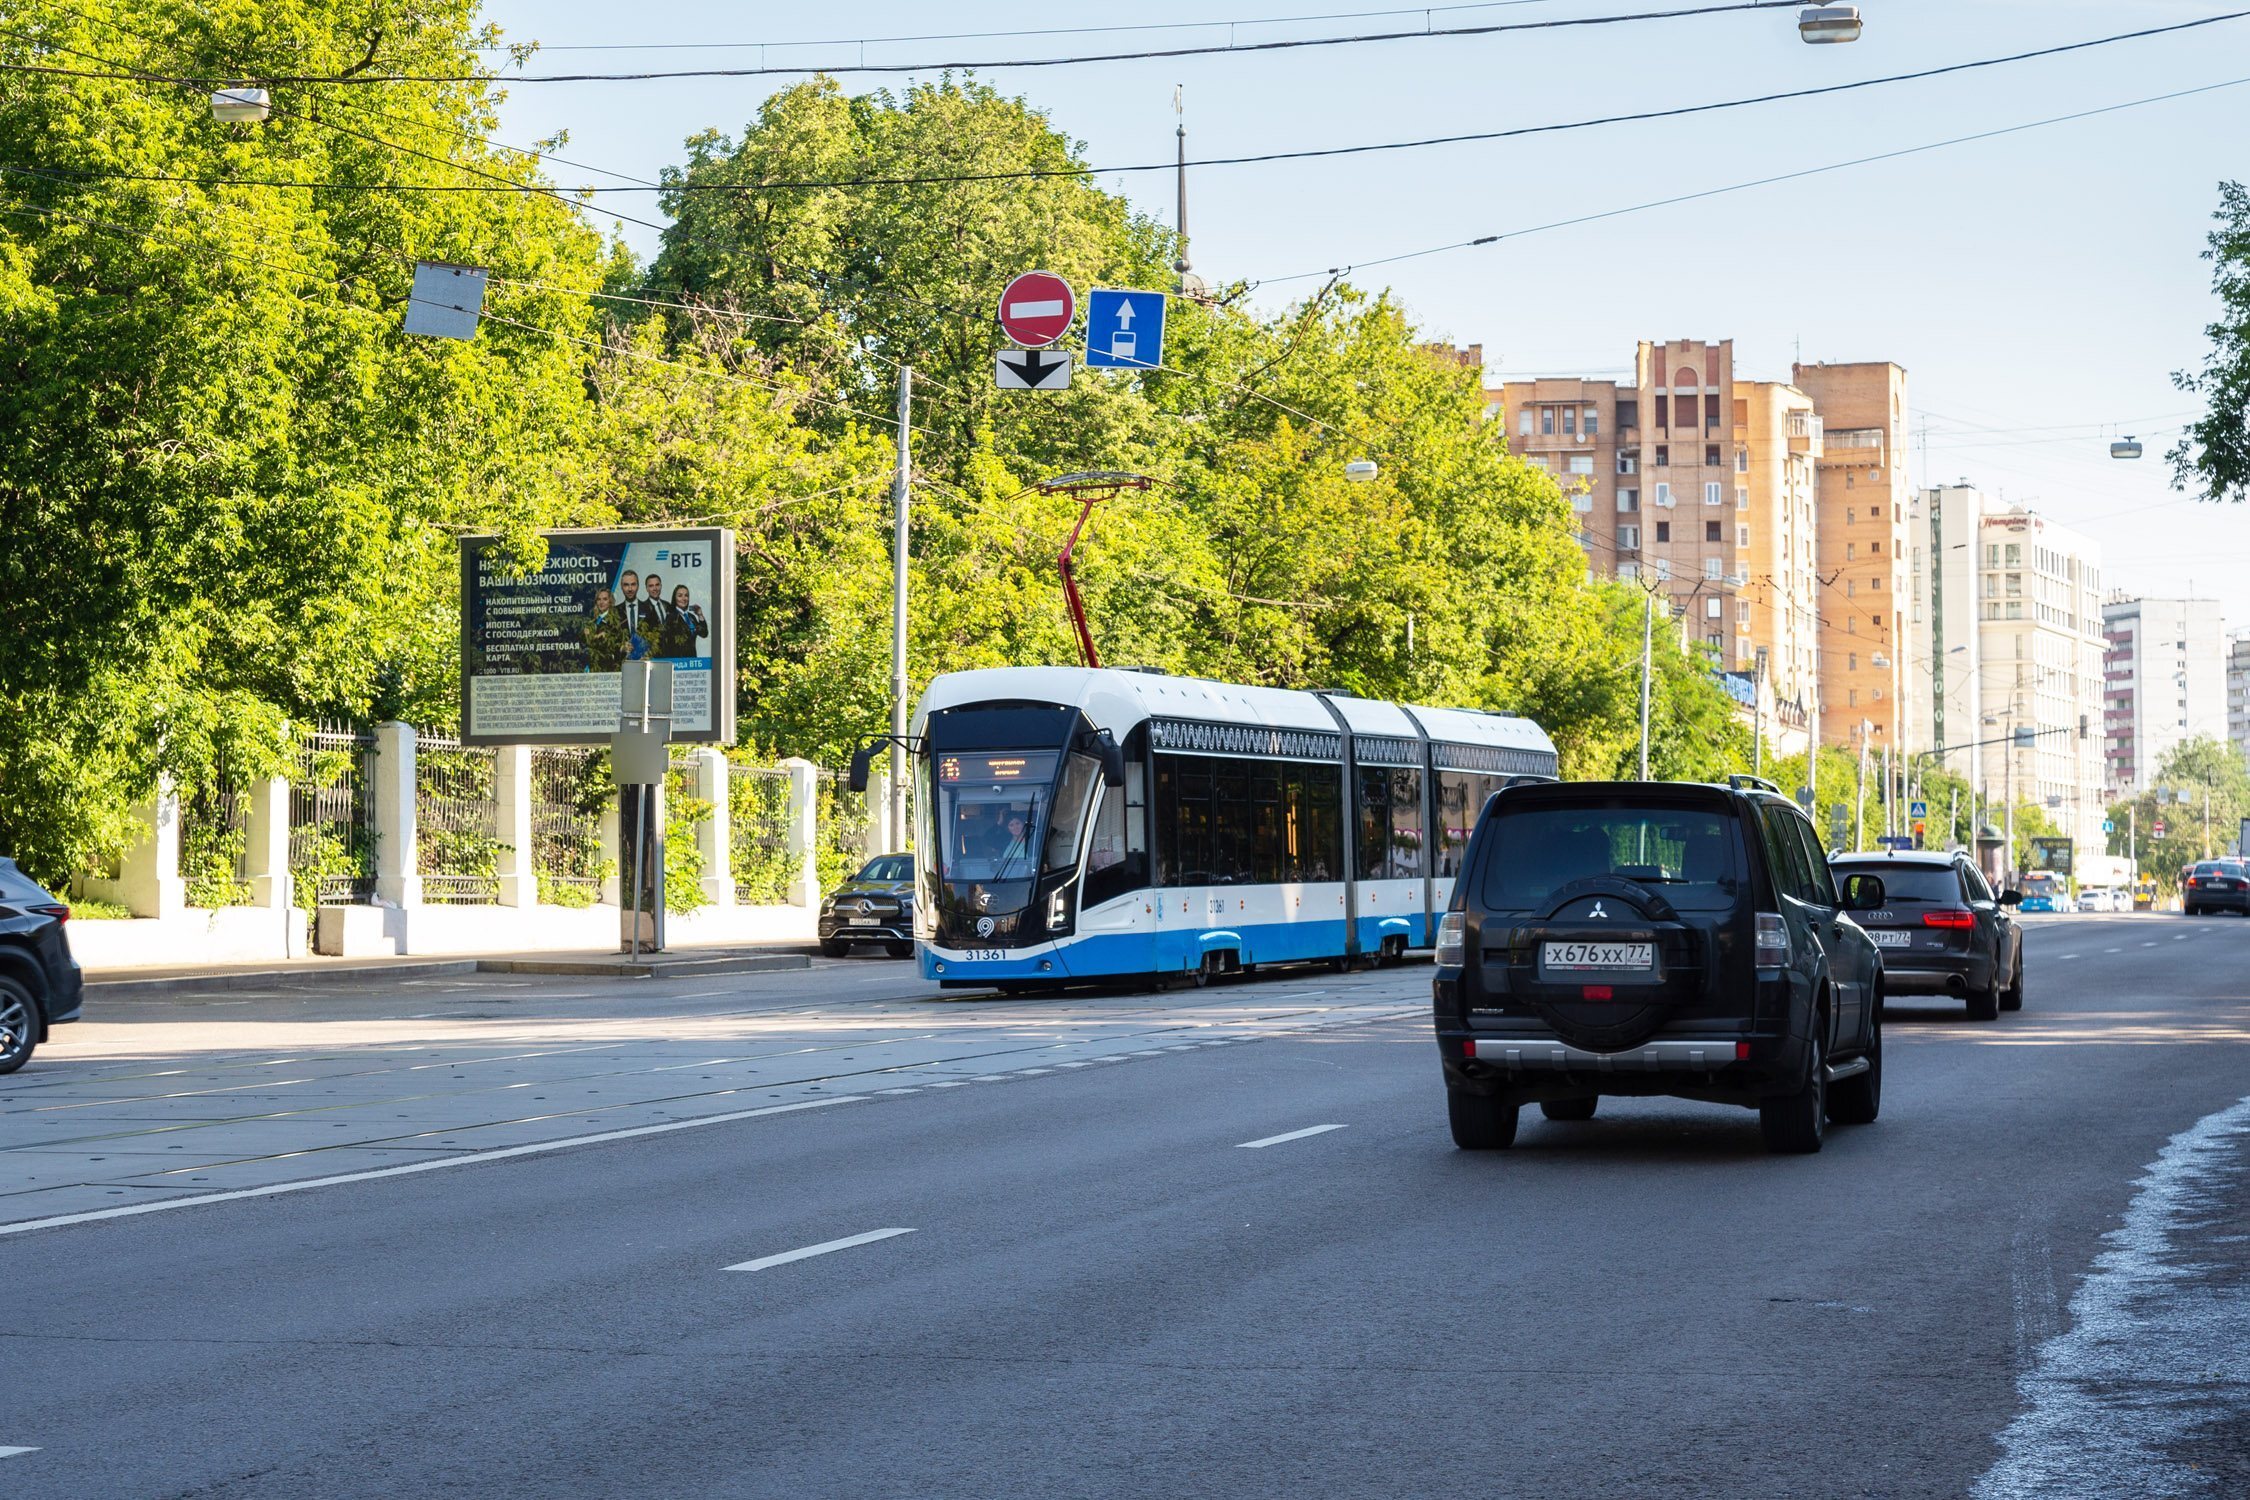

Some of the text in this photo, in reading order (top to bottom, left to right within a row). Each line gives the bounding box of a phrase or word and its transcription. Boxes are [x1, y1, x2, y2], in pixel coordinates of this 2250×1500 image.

[1984, 517, 2027, 527] Hampton
[671, 553, 702, 568] ВТБ
[480, 572, 607, 587] ВАШИ ВОЗМОЖНОСТИ
[486, 595, 572, 606] НАКОПИТЕЛЬНЫЙ СЧЕТ
[486, 604, 583, 615] С ПОВЫШЕННОЙ СТАВКОЙ
[486, 621, 521, 629] ИПОТЕКА
[493, 628, 559, 638] ГОСПОДДЕРЖКОЙ
[486, 643, 579, 652] БЕСПЛАТНАЯ ДЕБЕТОВАЯ
[486, 654, 510, 662] КАРТА
[689, 660, 703, 668] ВТБ
[1868, 932, 1894, 942] 98РТ
[966, 950, 1006, 960] 31361
[1629, 945, 1646, 958] 77
